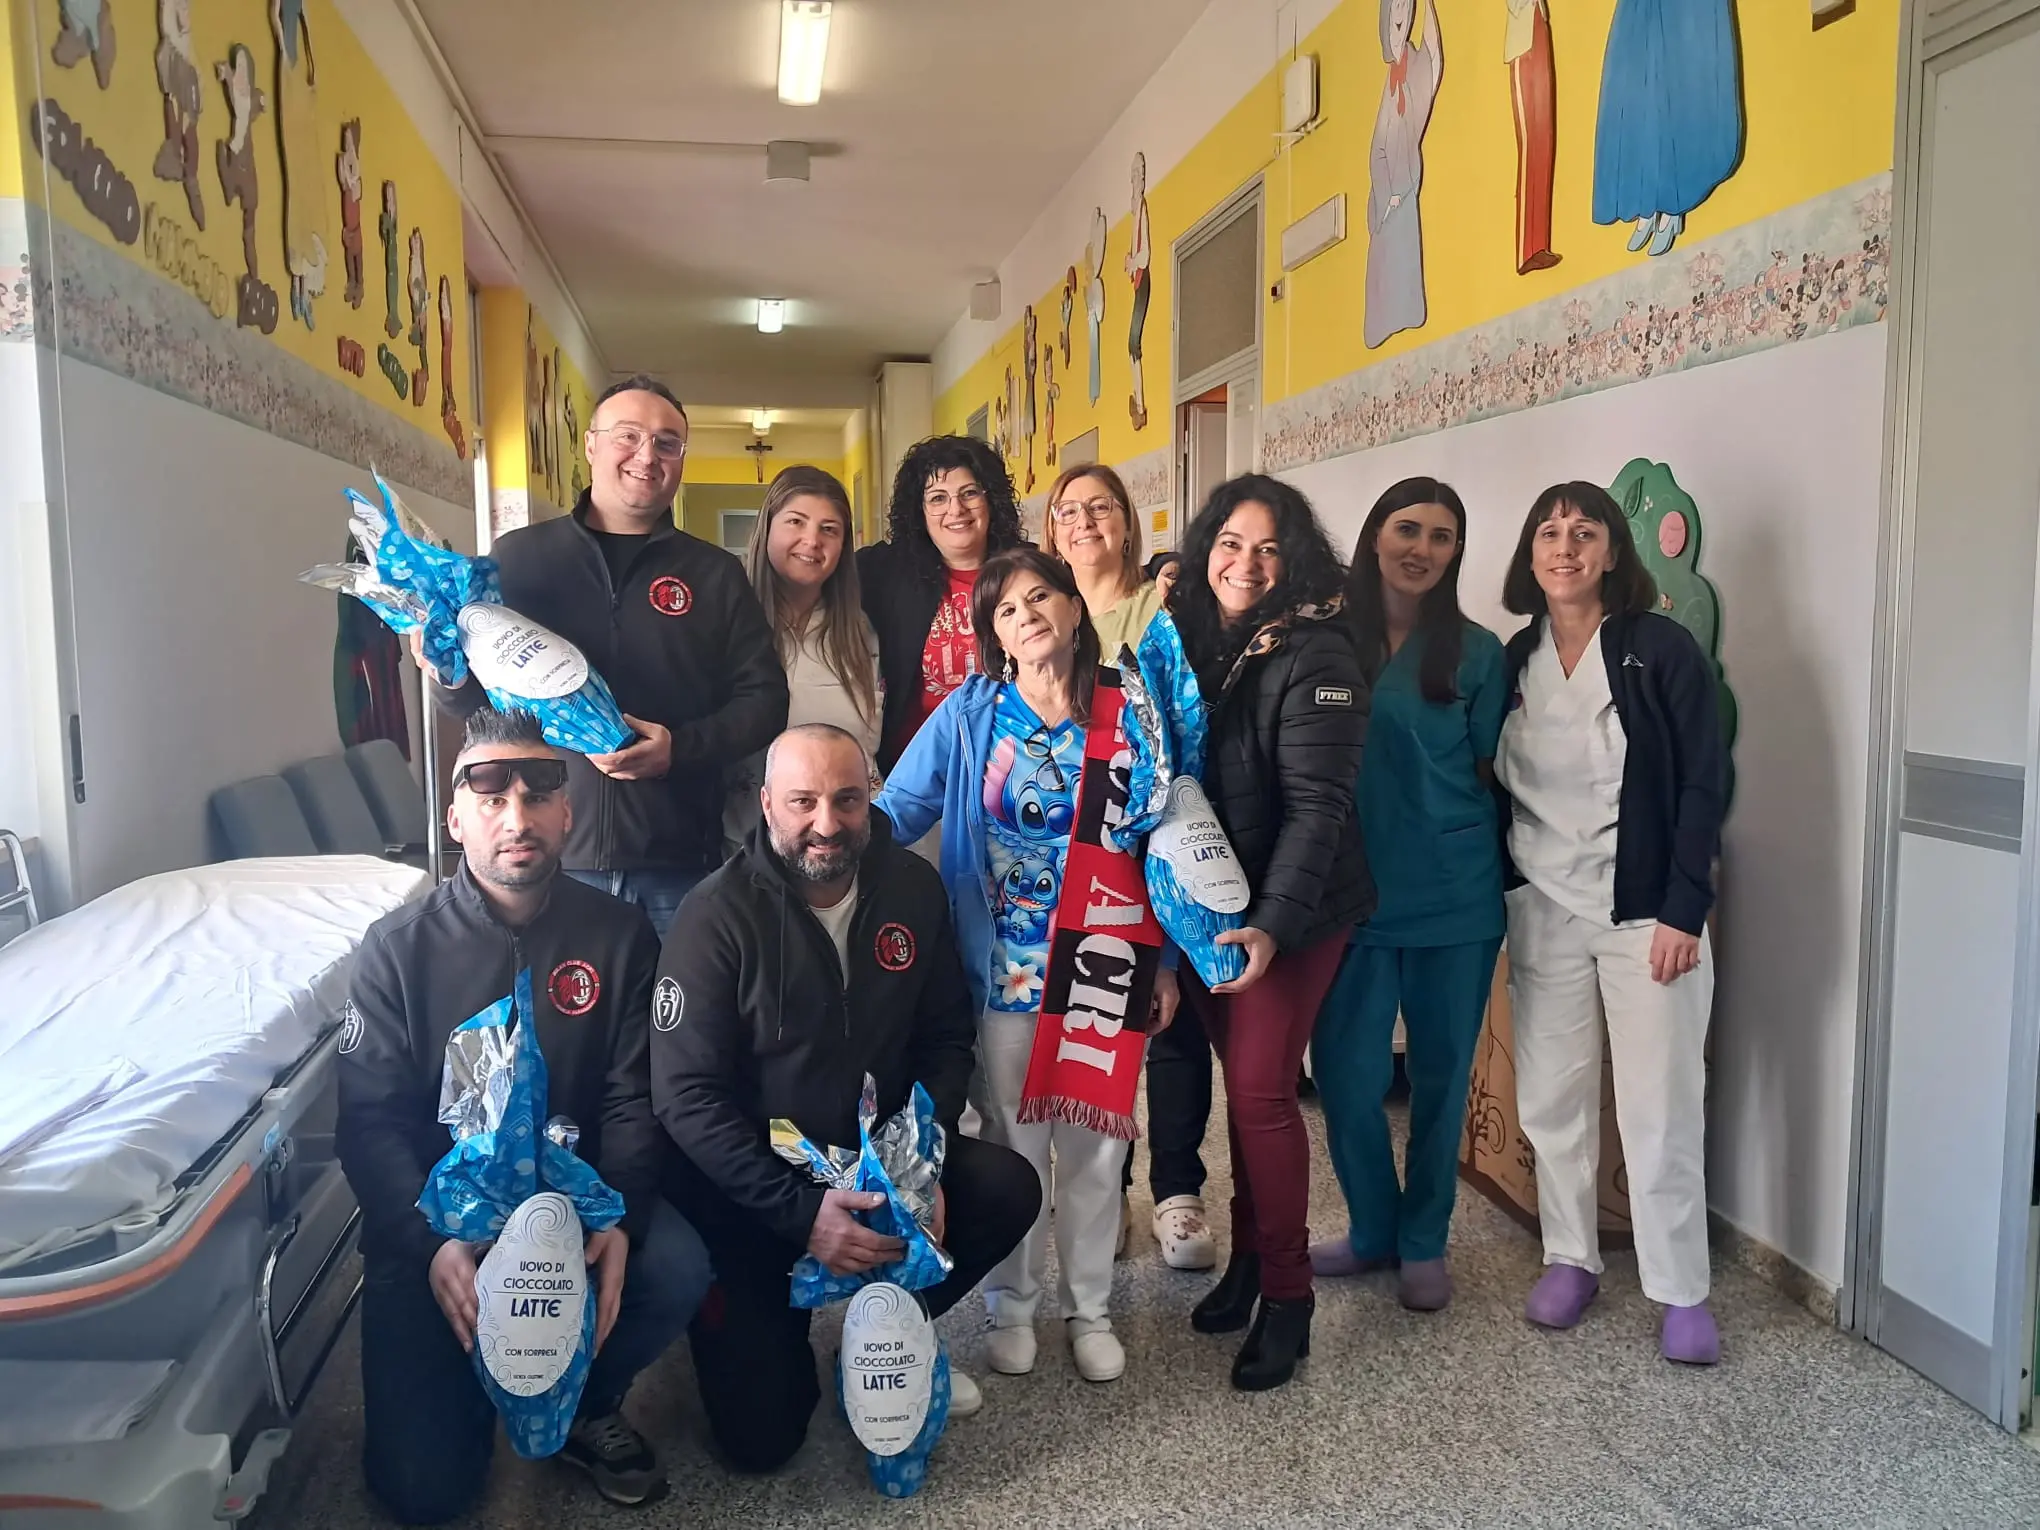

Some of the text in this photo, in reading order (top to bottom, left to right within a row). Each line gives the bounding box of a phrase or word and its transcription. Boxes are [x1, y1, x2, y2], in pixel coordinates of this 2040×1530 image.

[493, 630, 514, 649] UOVO
[496, 629, 539, 665] CIOCCOLATO
[512, 639, 548, 669] LATTE
[1186, 821, 1209, 831] UOVO
[1193, 846, 1229, 862] LATTE
[1055, 875, 1146, 1078] ACRI
[662, 1002, 671, 1017] 7
[520, 1261, 565, 1273] UOVO DI
[503, 1278, 574, 1290] CIOCCOLATO
[510, 1298, 562, 1318] LATTE
[505, 1348, 557, 1357] CON SORPRESA
[864, 1341, 904, 1352] UOVO DI
[854, 1354, 916, 1367] CIOCCOLATO
[863, 1373, 907, 1391] LATTE
